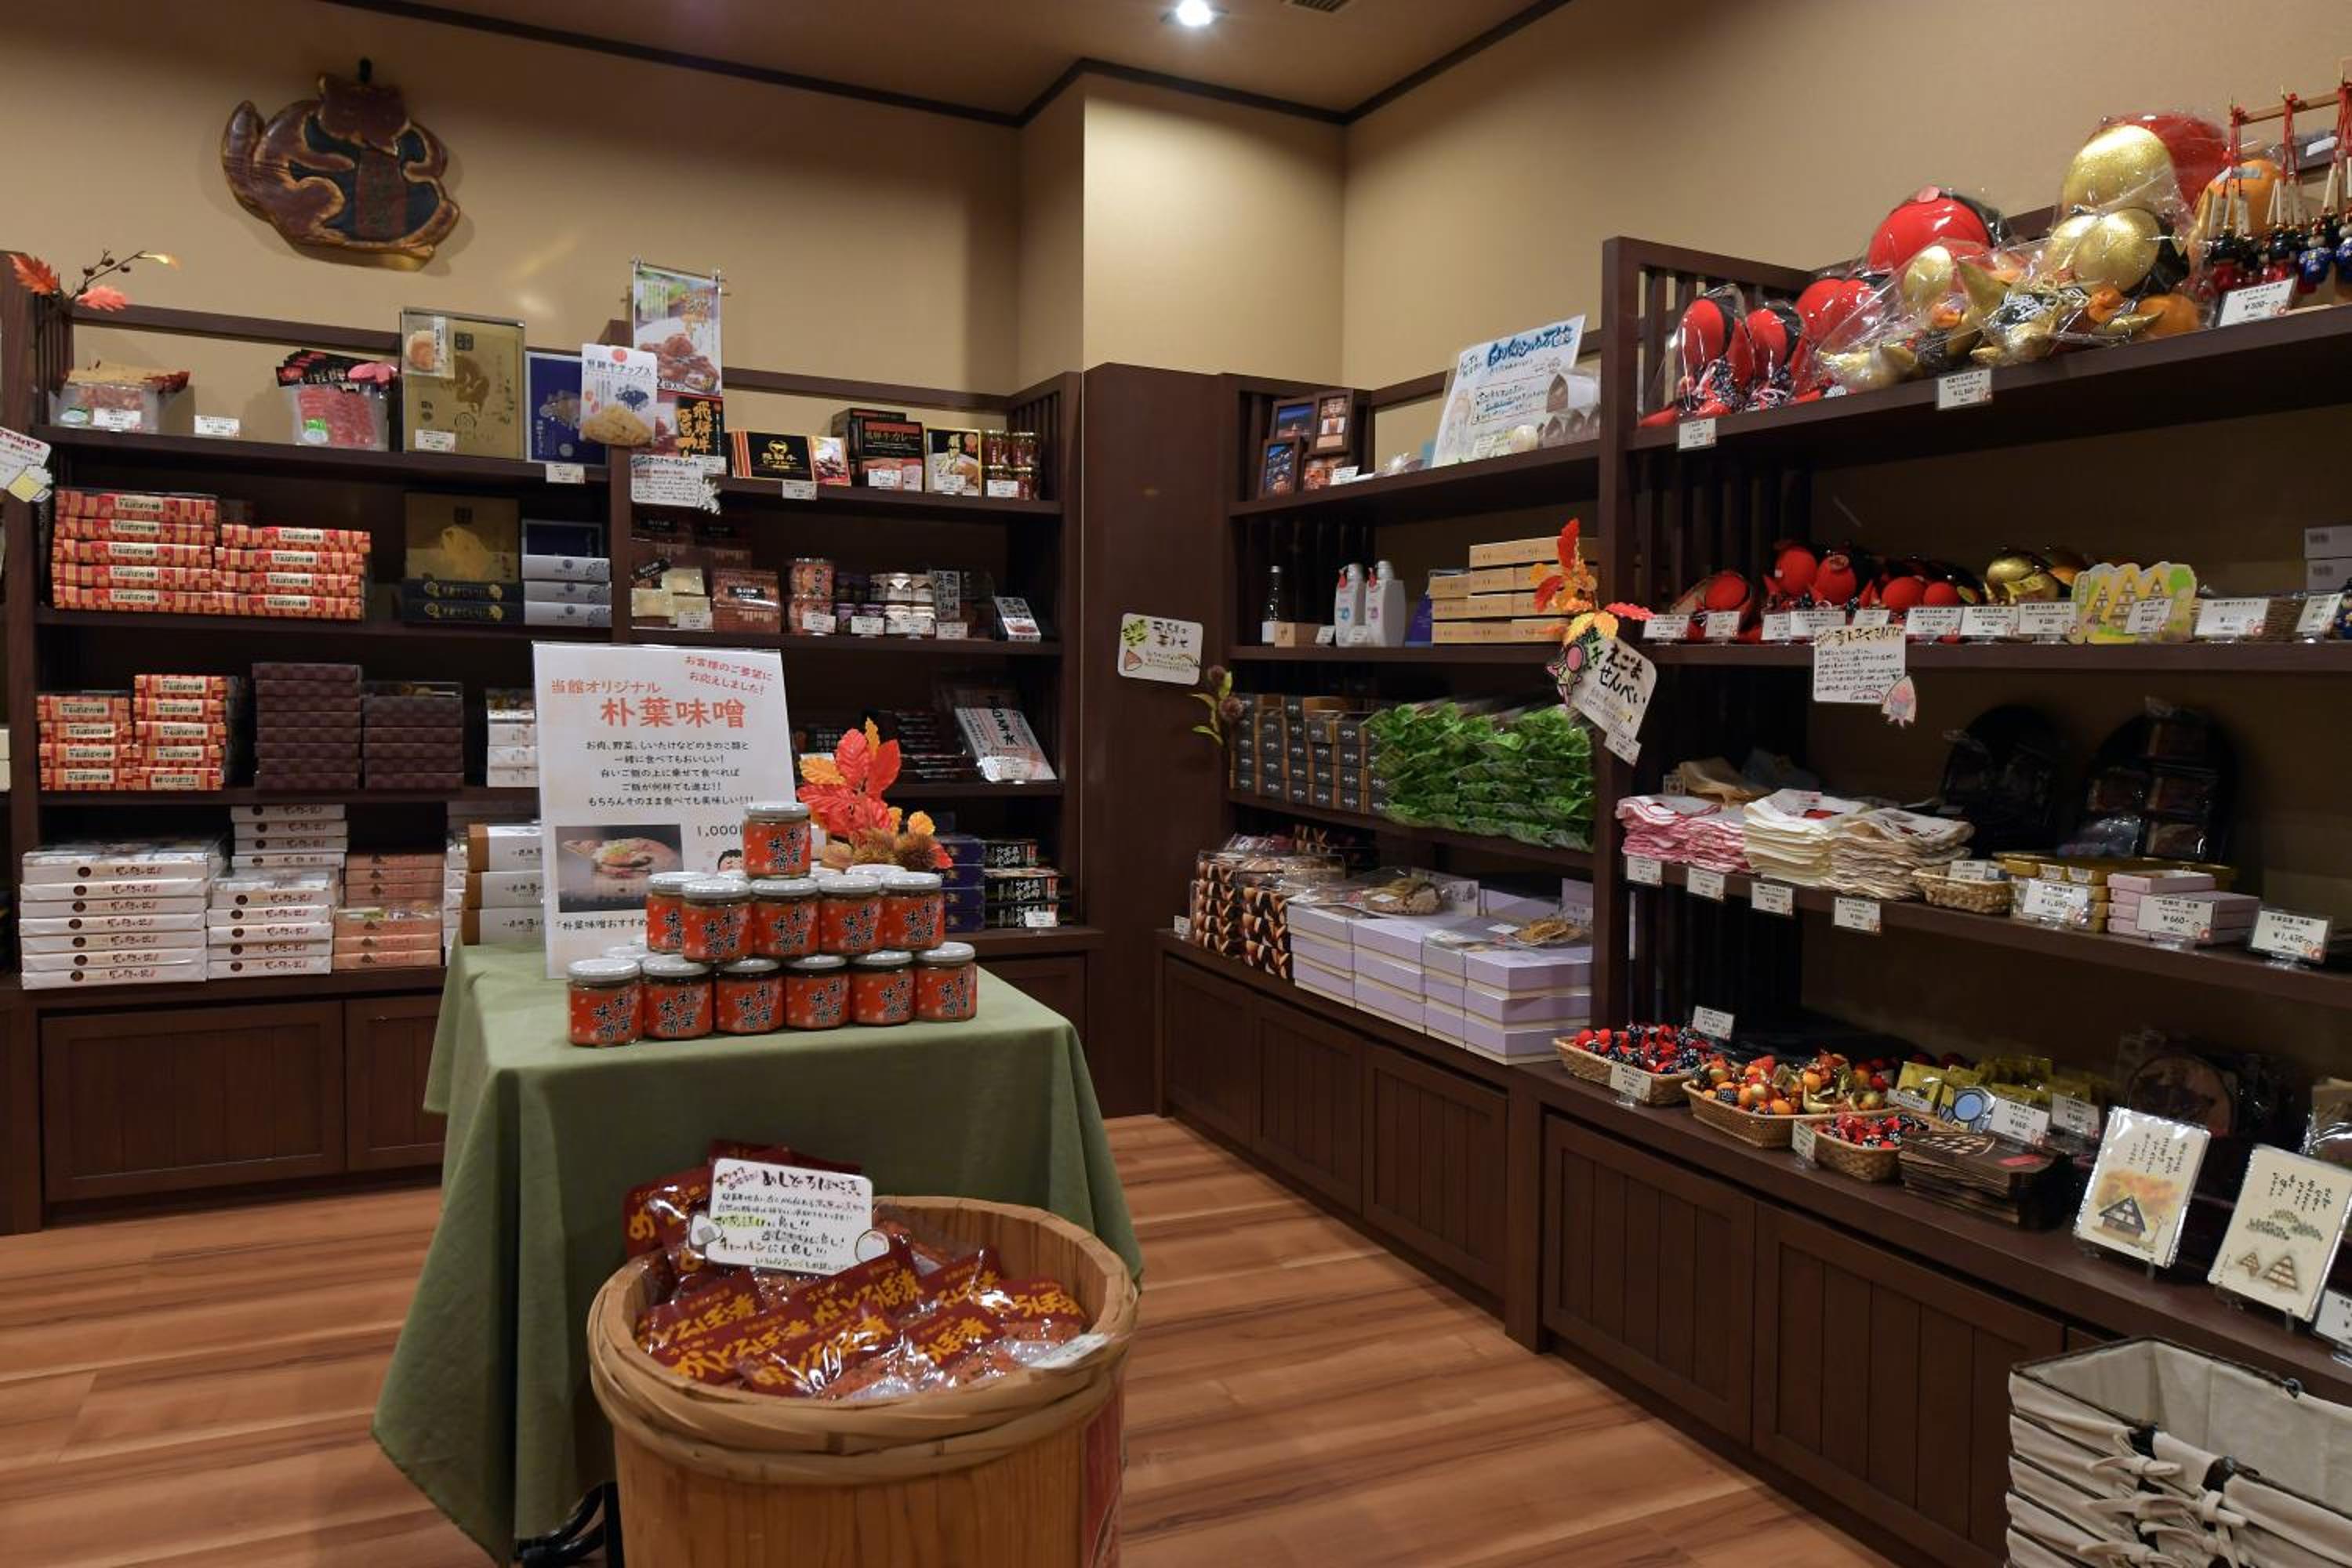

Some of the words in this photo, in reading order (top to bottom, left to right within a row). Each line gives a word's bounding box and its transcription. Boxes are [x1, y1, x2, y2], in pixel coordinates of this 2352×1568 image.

[684, 655, 774, 681] お客様のご要望に
[1606, 643, 1643, 681] えごま
[551, 679, 662, 694] 当館オリジナル
[690, 672, 764, 695] お応えしました!
[1599, 666, 1646, 704] せんべい
[601, 697, 746, 728] 朴葉味噌
[586, 741, 750, 750] お肉、野菜、しいたけなどのきのこ類と
[614, 755, 724, 764] 一緒に食べてもおいしい!
[601, 768, 740, 778] 白いご飯の上に乗せて食べれば
[696, 825, 745, 839] 1,000
